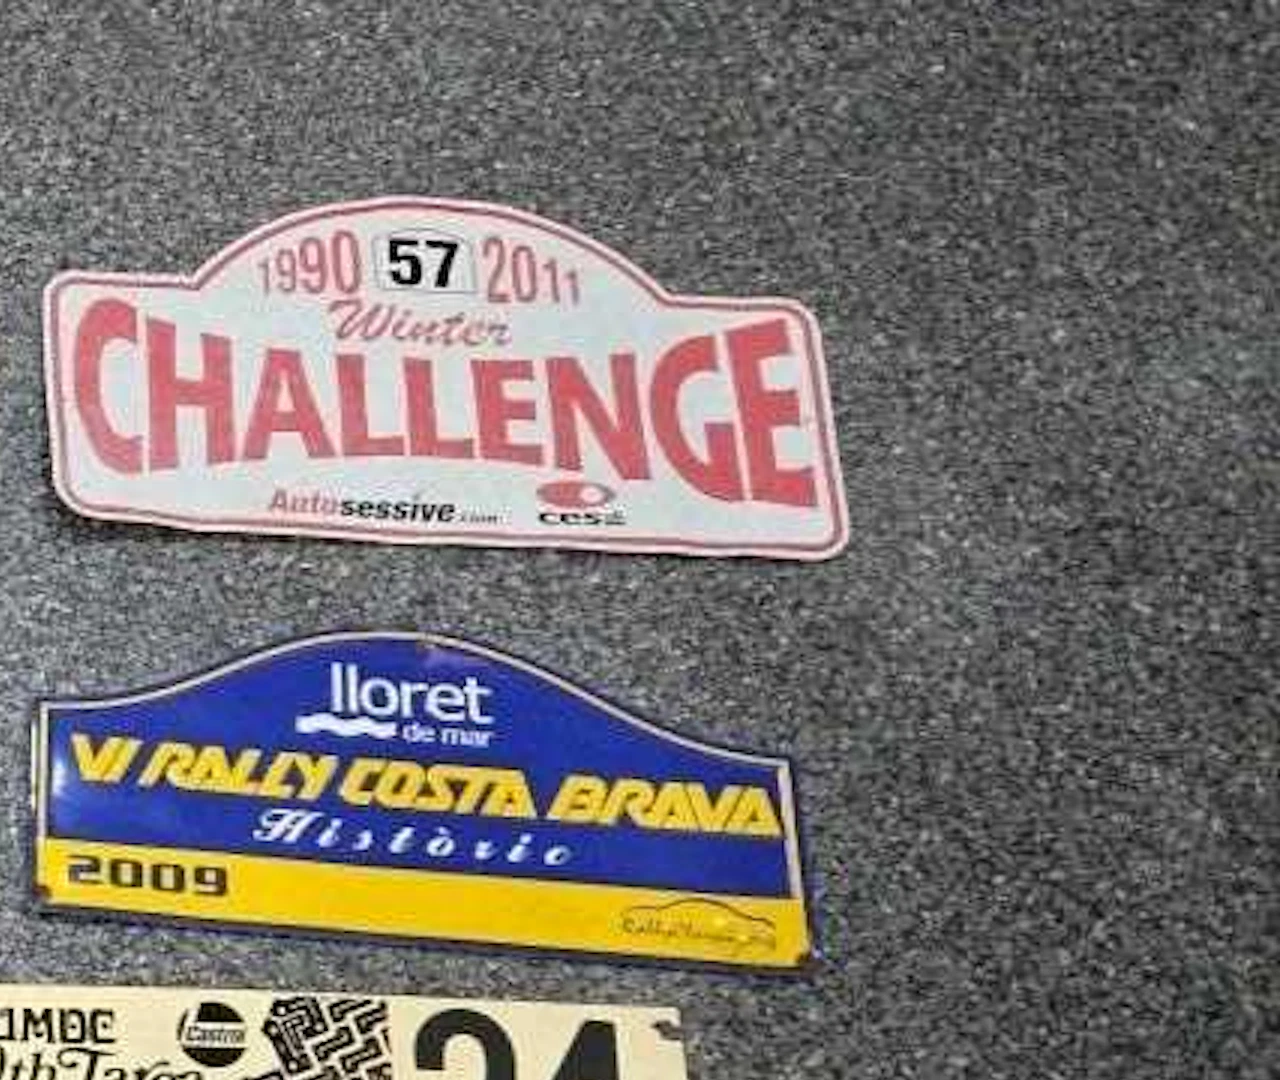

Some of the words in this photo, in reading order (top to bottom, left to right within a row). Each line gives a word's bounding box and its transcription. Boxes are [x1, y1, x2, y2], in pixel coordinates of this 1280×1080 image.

[259, 231, 361, 296] 1990
[388, 240, 459, 286] 57
[485, 238, 580, 304] 2011
[328, 298, 514, 346] Winter
[73, 298, 818, 508] CHALLENGE
[332, 662, 493, 723] lloret
[403, 723, 436, 742] de
[441, 728, 493, 746] mar
[70, 733, 143, 782] VI
[139, 746, 336, 801] RALLY
[340, 761, 537, 817] COSTA
[547, 774, 787, 837] BRAVA
[68, 855, 228, 897] 2009
